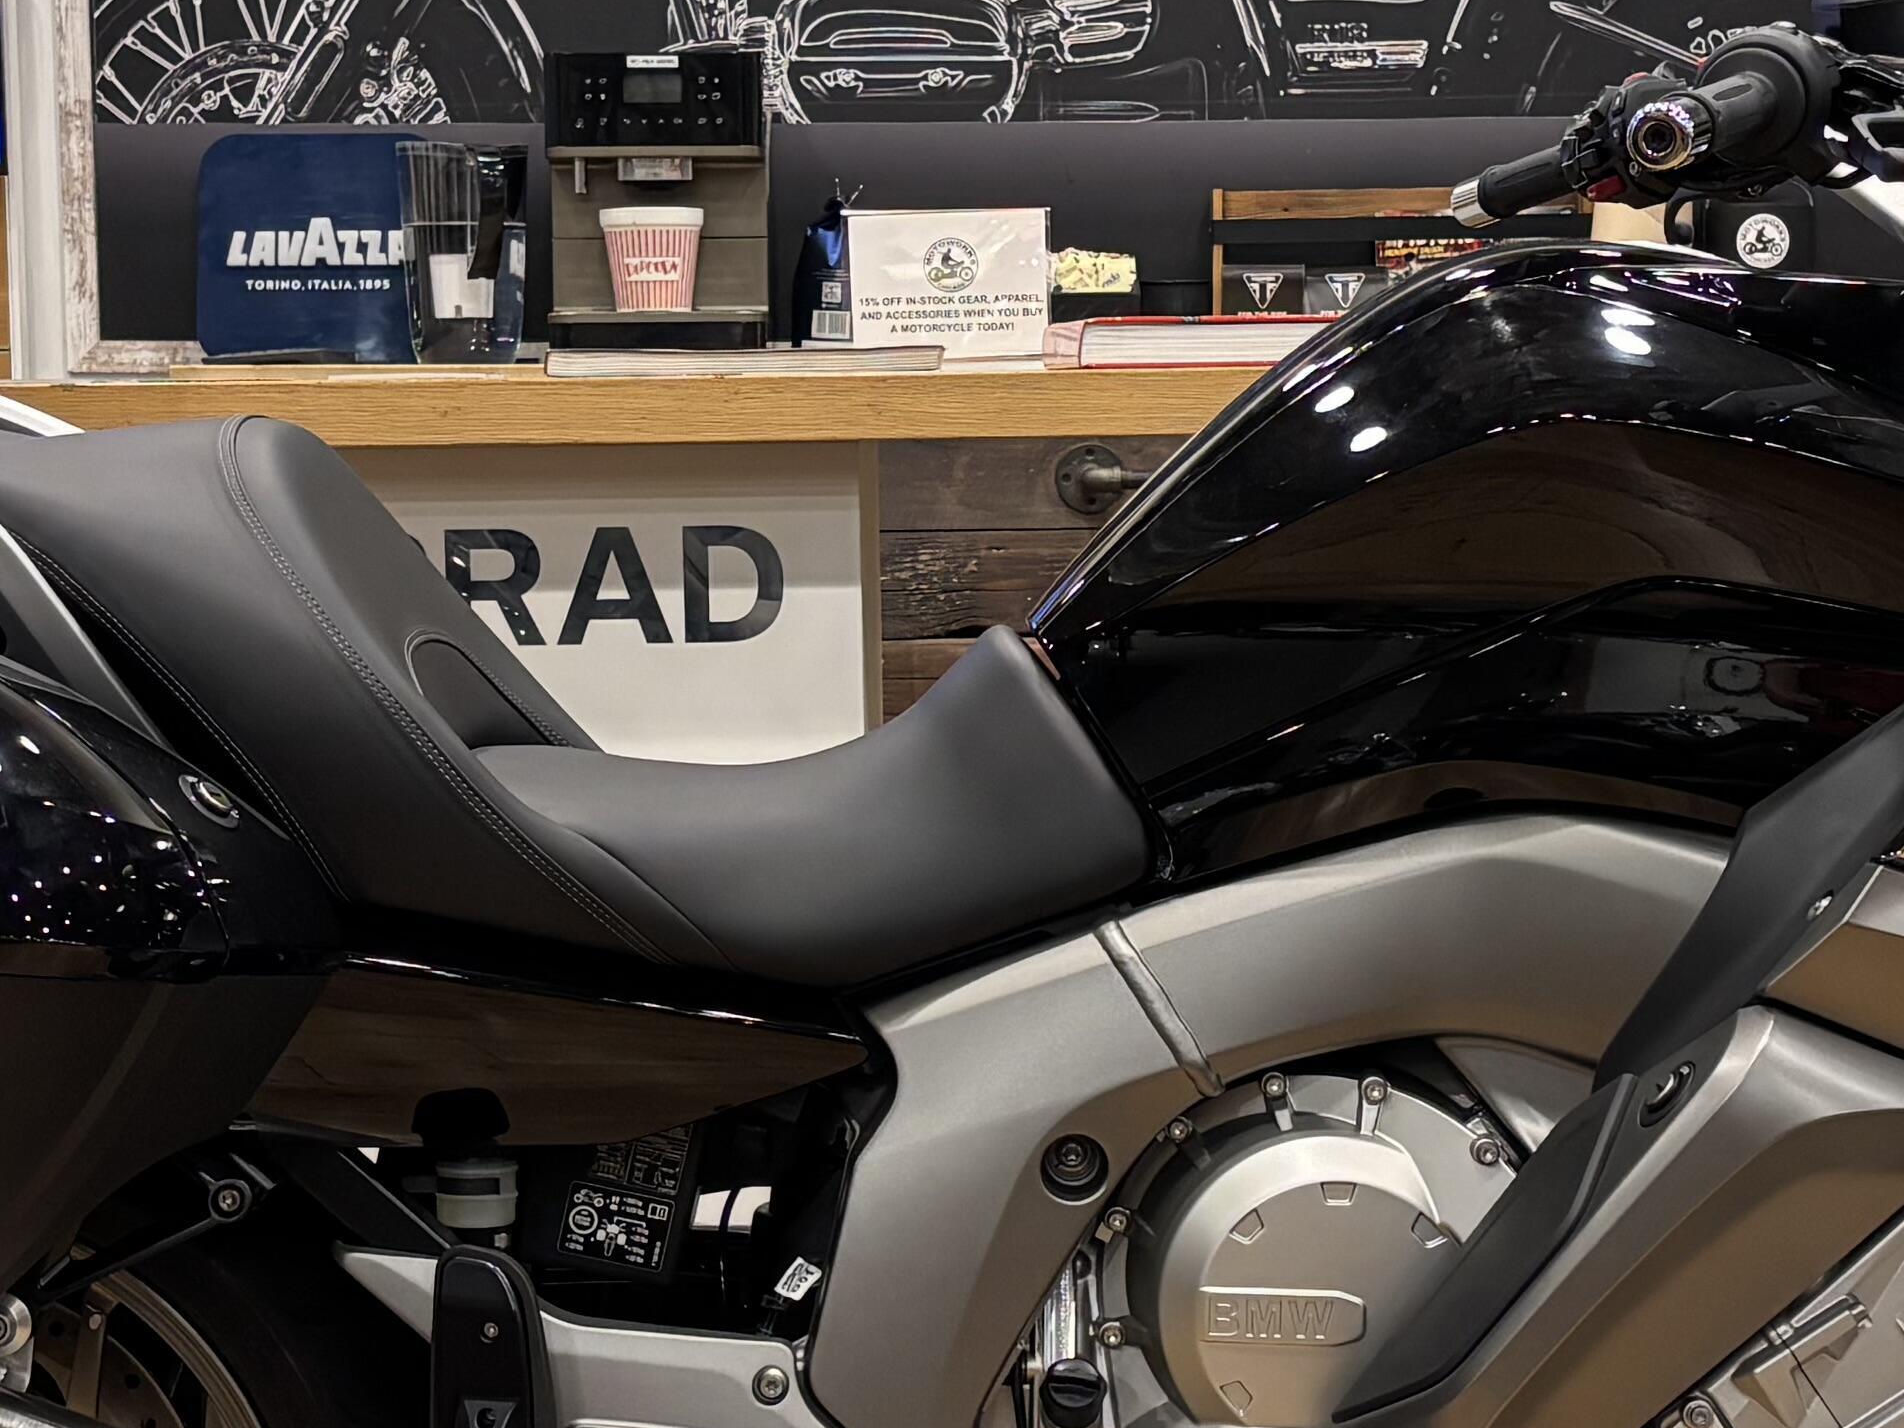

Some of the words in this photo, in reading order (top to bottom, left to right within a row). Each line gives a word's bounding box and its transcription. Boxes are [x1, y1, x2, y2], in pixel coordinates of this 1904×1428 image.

[226, 217, 416, 266] LAVAZZA
[358, 279, 391, 290] 1895
[859, 297, 880, 307] 15%
[882, 296, 902, 306] OFF
[906, 295, 956, 306] IN-STOCK
[860, 311, 882, 321] AND
[885, 309, 961, 320] ACCESSORIES
[962, 308, 995, 318] WHEN
[997, 308, 1021, 317] YOU
[1022, 307, 1044, 317] BUY
[890, 324, 899, 333] A
[900, 323, 973, 333] MOTORCYCLE
[977, 322, 1015, 332] TODAY!
[407, 525, 784, 645] RAD
[1208, 1297, 1335, 1340] BMW
